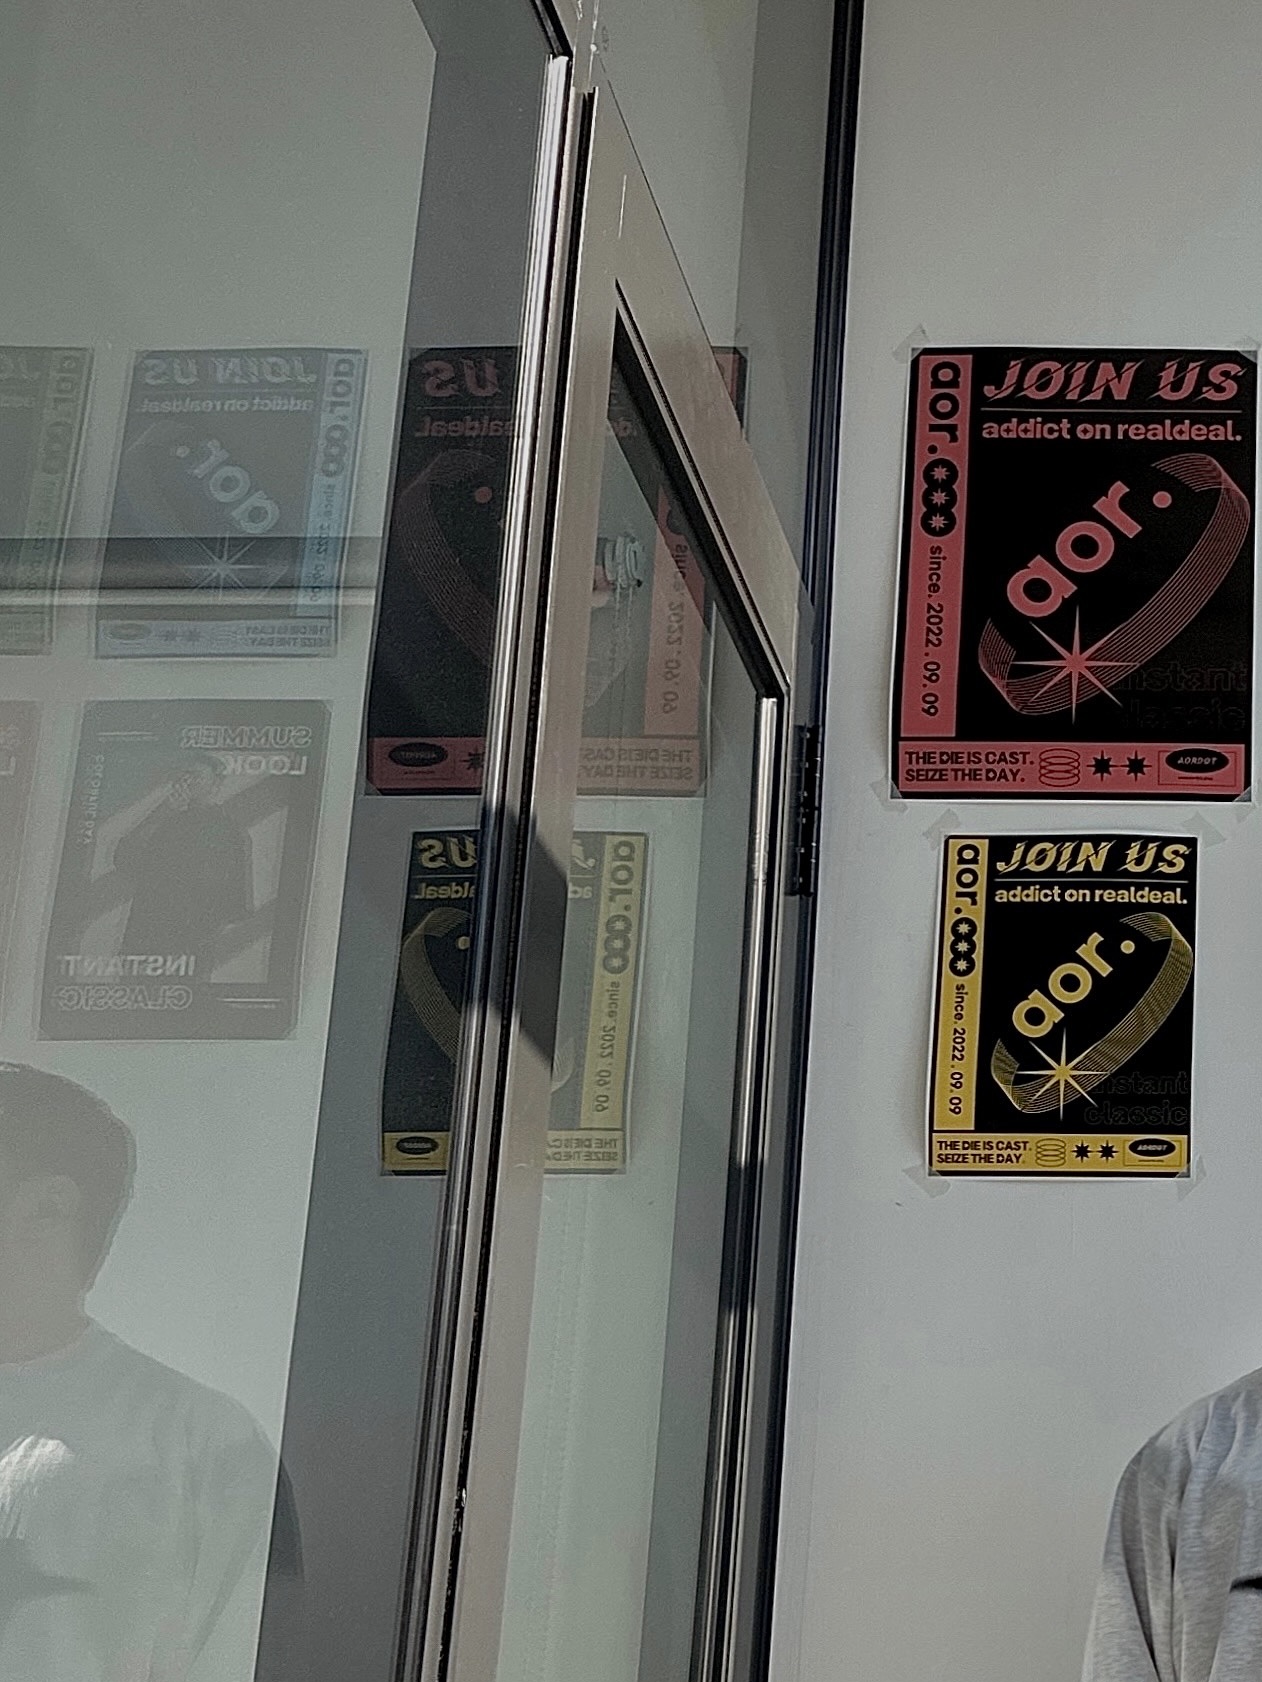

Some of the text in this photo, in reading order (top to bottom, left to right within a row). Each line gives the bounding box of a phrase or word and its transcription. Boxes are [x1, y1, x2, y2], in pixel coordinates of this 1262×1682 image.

[983, 359, 1247, 401] JOIN US
[927, 361, 961, 455] aor.
[982, 418, 1242, 441] addict on realdeal.
[1007, 481, 1172, 617] aor.
[905, 752, 1034, 765] THE DIE IS CAST.
[905, 768, 1025, 782] SEIZE THE DAY.
[997, 840, 1191, 875] JOIN US
[955, 844, 980, 915] aor.
[995, 885, 1187, 904] addict on realdeal.
[1012, 932, 1135, 1038] aor.
[937, 1141, 1032, 1151] THE DIE IS CAST.
[937, 1153, 969, 1164] SEIZE
[971, 1153, 994, 1164] THE
